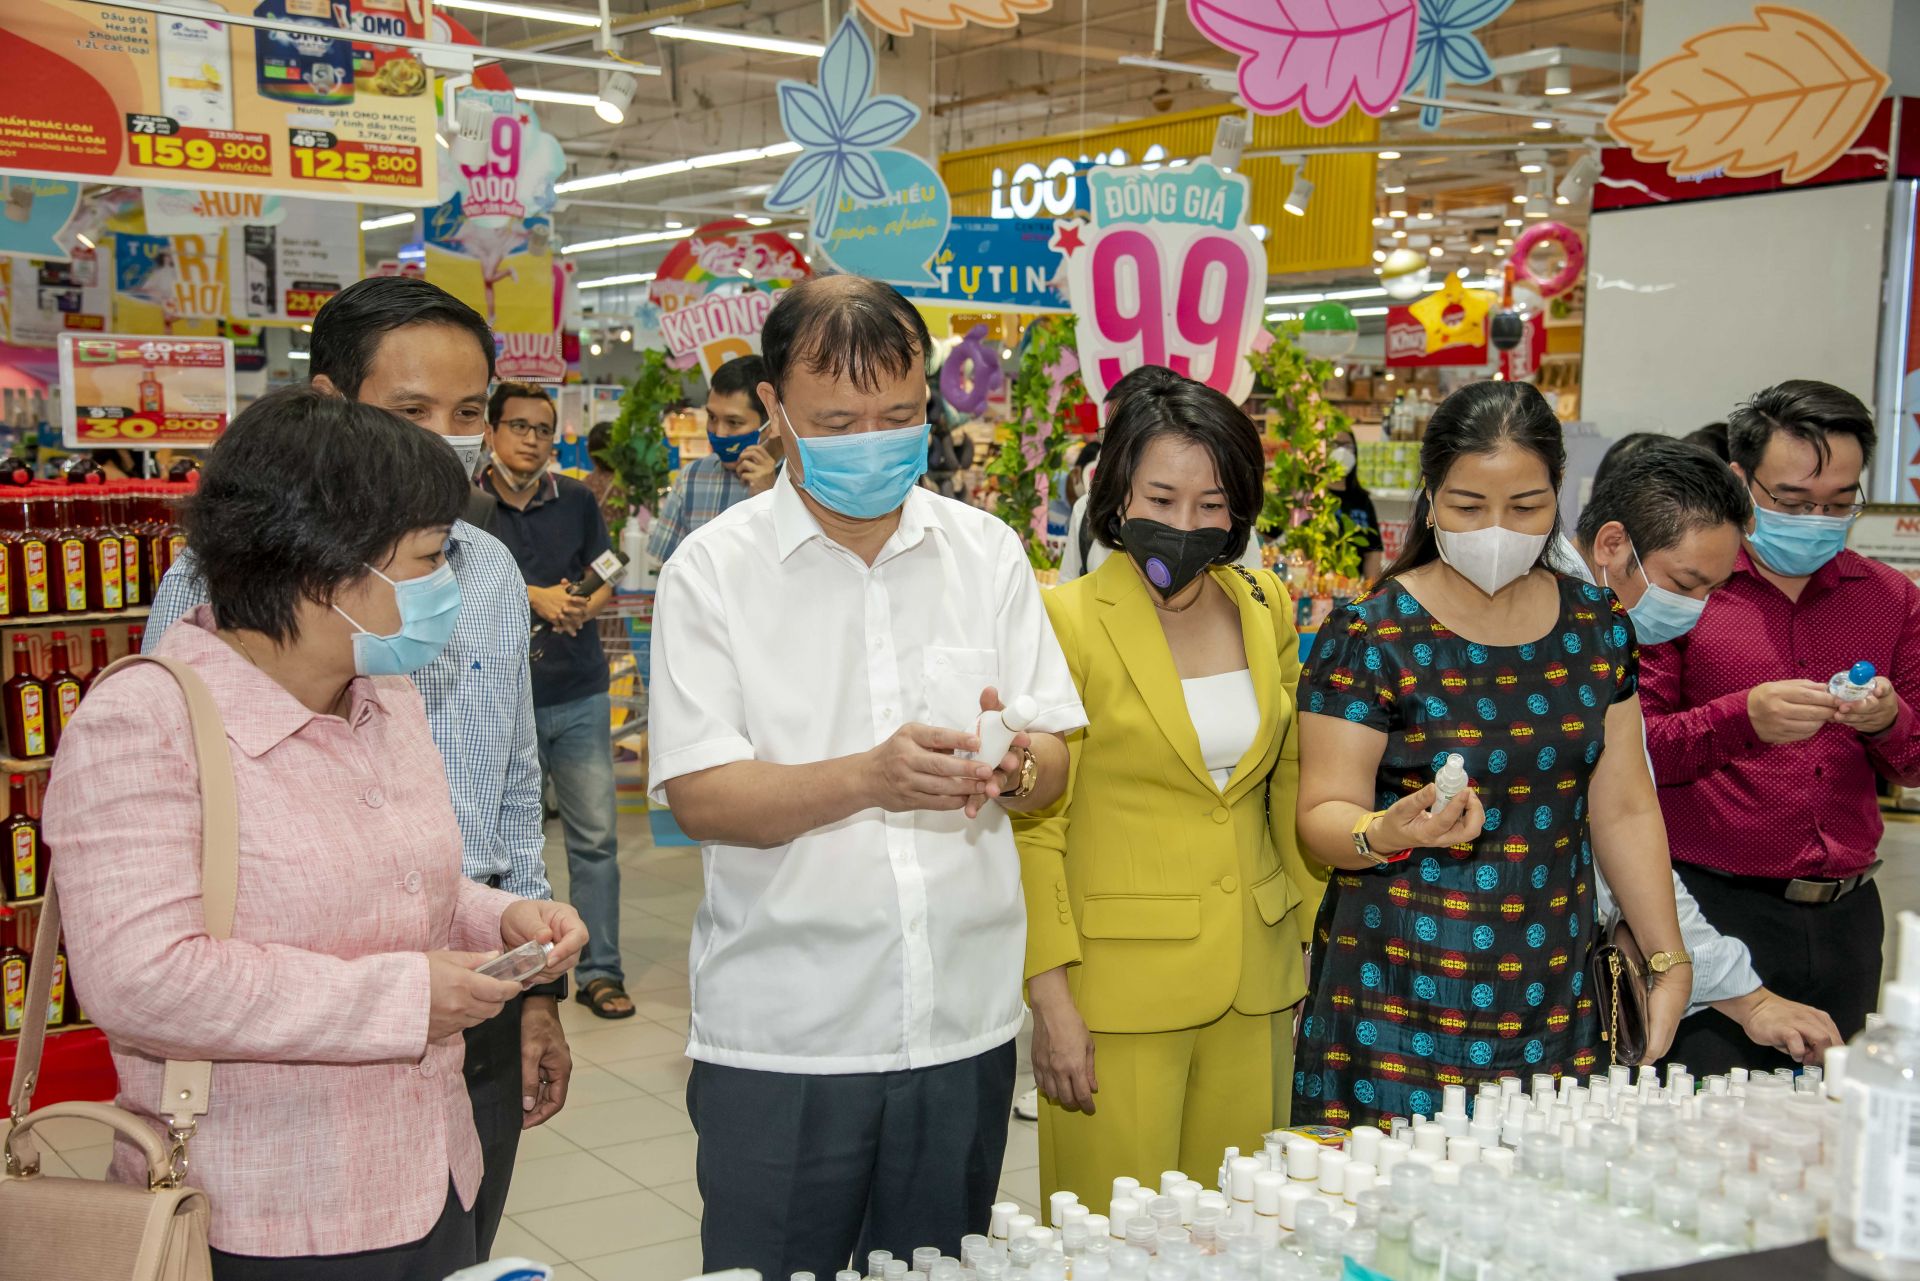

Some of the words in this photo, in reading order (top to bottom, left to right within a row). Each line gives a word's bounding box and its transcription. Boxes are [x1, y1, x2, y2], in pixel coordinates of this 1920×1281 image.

[105, 23, 136, 33] Head
[363, 15, 405, 37] OMO
[88, 31, 149, 45] Shoulders
[383, 114, 416, 123] MATIC
[1105, 174, 1177, 220] ĐỒNG
[1184, 185, 1228, 224] GIÁ
[1093, 230, 1249, 396] 99
